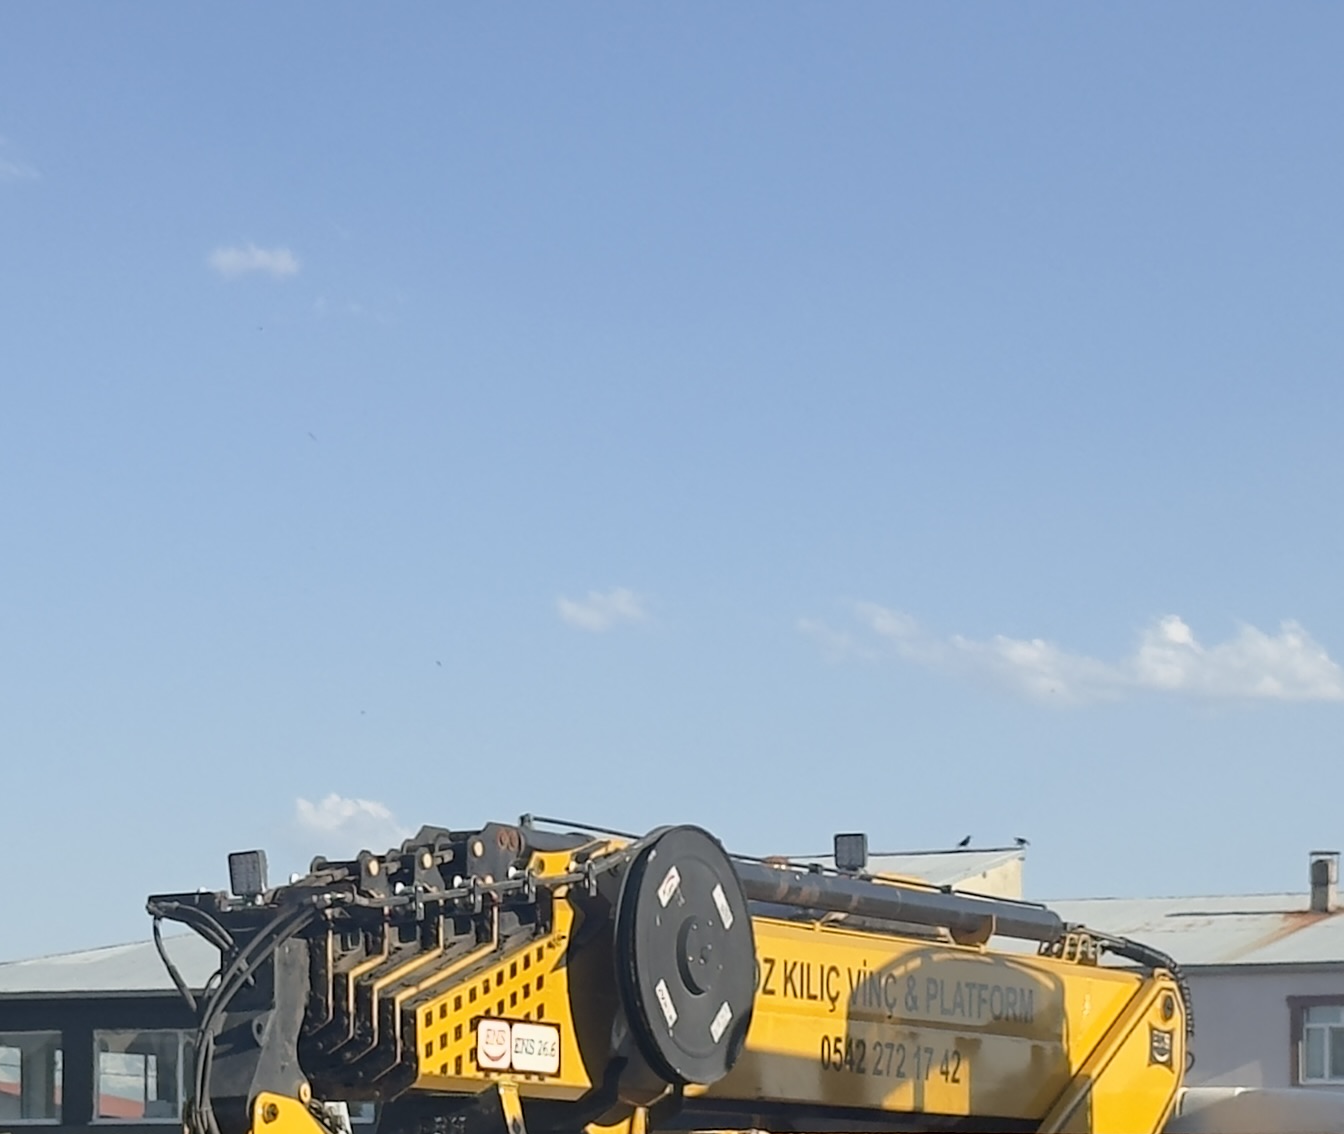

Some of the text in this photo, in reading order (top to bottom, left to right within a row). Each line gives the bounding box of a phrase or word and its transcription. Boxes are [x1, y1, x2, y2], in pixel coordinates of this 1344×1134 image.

[783, 960, 840, 1012] KILIÇ
[847, 960, 897, 1019] VİNÇ
[905, 976, 918, 1013] &
[926, 977, 1034, 1024] PLATFORM
[821, 1035, 961, 1083] 0542 272 17 42
